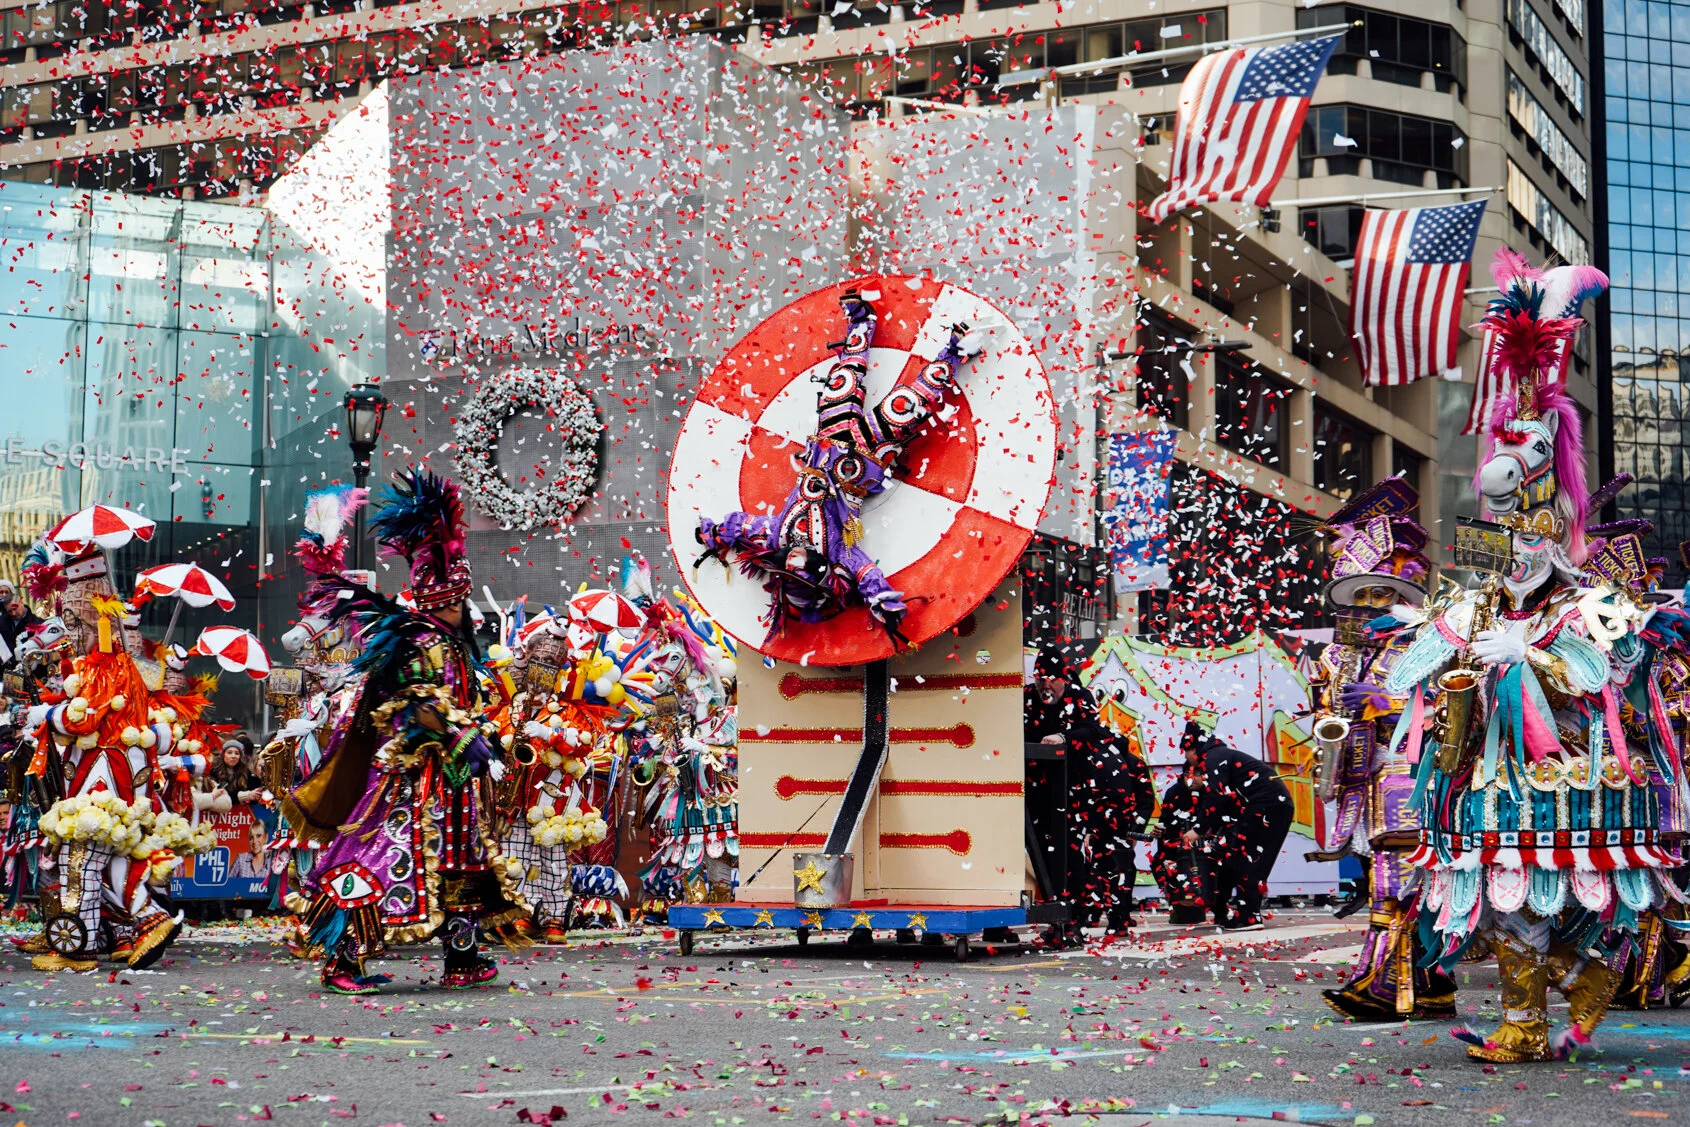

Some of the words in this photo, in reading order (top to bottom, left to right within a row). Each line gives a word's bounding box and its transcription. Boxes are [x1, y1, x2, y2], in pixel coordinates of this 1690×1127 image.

[523, 317, 653, 351] Medicine
[6, 437, 25, 464] E
[42, 440, 189, 475] SQUARE
[1351, 538, 1377, 565] TICKET
[1598, 551, 1624, 577] TICKE
[1619, 541, 1640, 575] TICKET
[1352, 734, 1366, 770] TICKET
[202, 811, 218, 827] ily
[219, 811, 252, 827] Night
[1341, 797, 1358, 833] TICKET
[199, 850, 225, 866] PHL
[212, 867, 225, 883] 17
